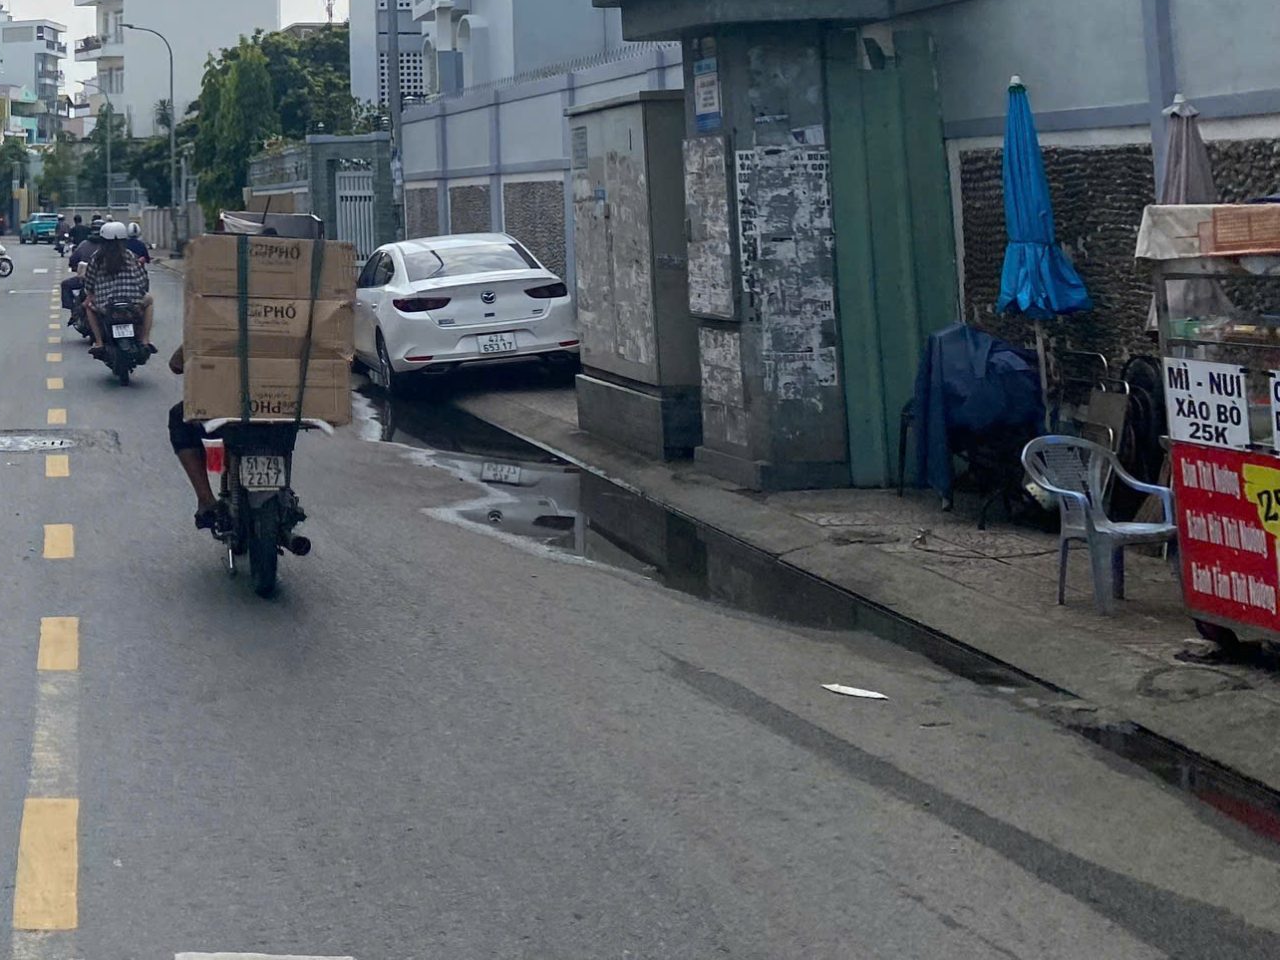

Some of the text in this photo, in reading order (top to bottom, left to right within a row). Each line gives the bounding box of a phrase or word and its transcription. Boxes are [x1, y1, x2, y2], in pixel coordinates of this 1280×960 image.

[263, 302, 297, 319] PHỐ
[1167, 362, 1190, 391] MÌ
[1175, 394, 1241, 427] XÀO BÒ
[1188, 422, 1229, 445] 25K
